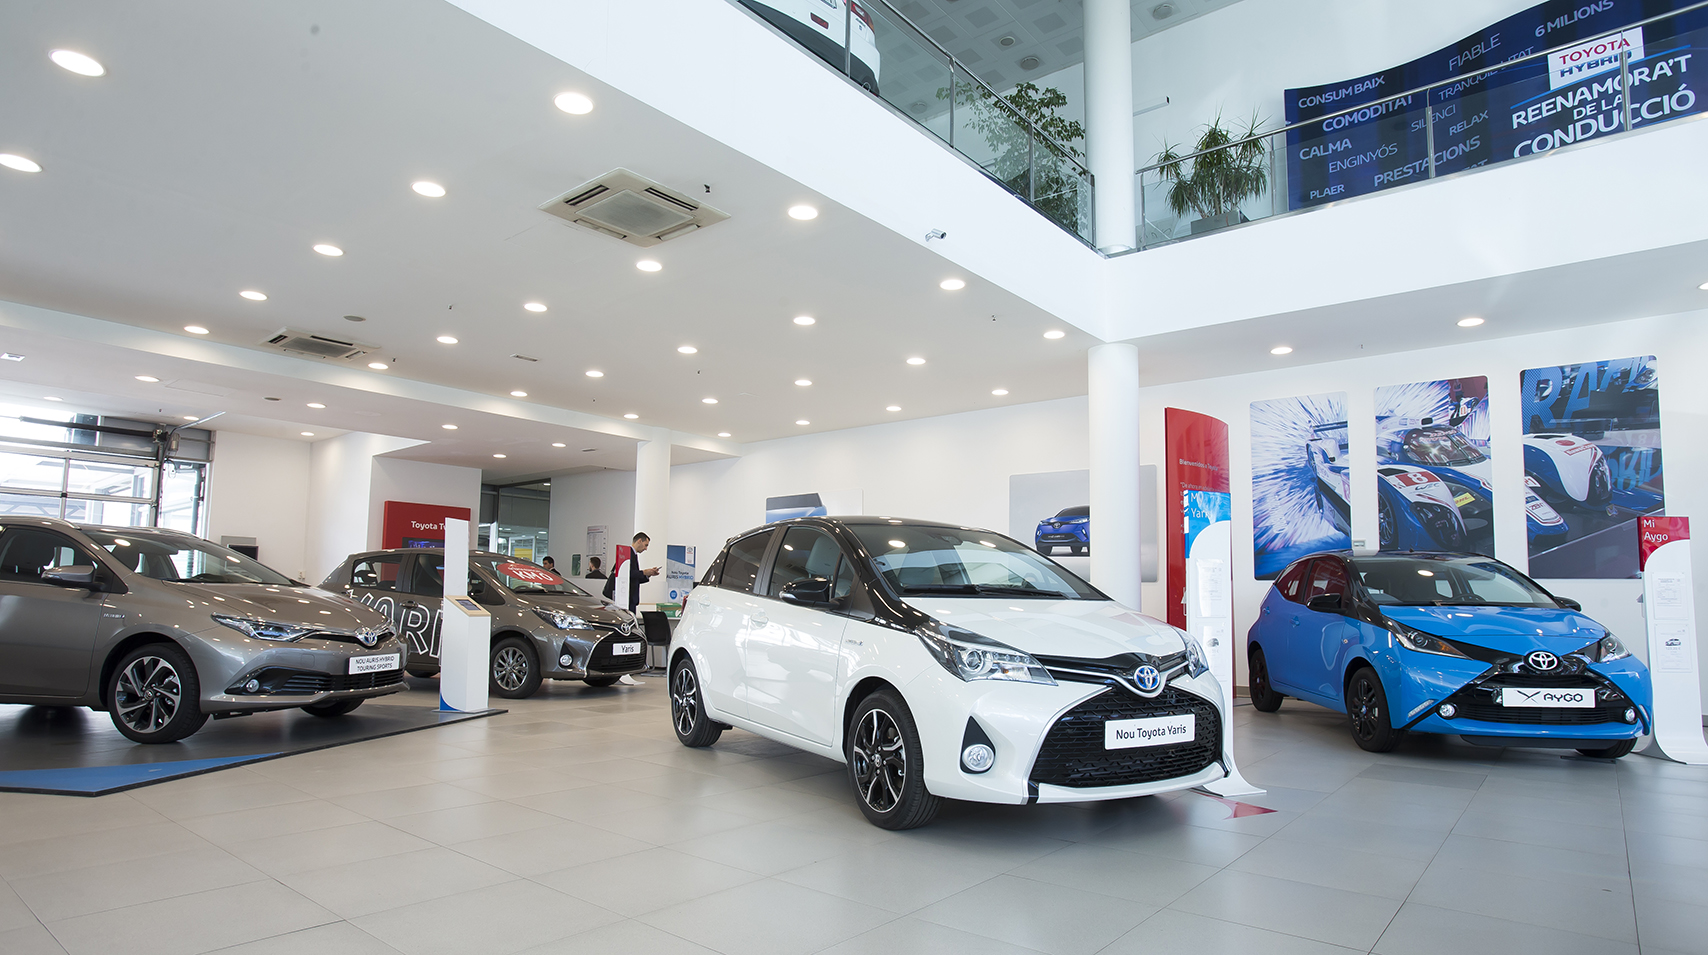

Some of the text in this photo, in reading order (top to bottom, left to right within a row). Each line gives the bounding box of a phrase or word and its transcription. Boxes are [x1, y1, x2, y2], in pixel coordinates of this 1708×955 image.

[1535, 0, 1615, 37] 6 MILIONS
[1449, 33, 1502, 71] FIABLE
[1559, 38, 1631, 65] TOYOTA
[1298, 75, 1386, 109] CONSUM BAIX
[1573, 102, 1597, 120] DE
[1449, 110, 1489, 136] RELAX
[1300, 138, 1352, 160] CALMA
[1328, 143, 1398, 173] ENGINYÓS
[1374, 135, 1481, 187] PRESTACIONS
[1310, 184, 1345, 200] PLAER
[1407, 472, 1429, 484] 8
[411, 520, 438, 530] Toyota
[1643, 519, 1655, 528] Mi
[1644, 532, 1669, 543] Aygo
[621, 645, 635, 653] Yaris
[1543, 693, 1584, 703] AYGO
[1116, 724, 1187, 741] Nou Toyota Yaris
